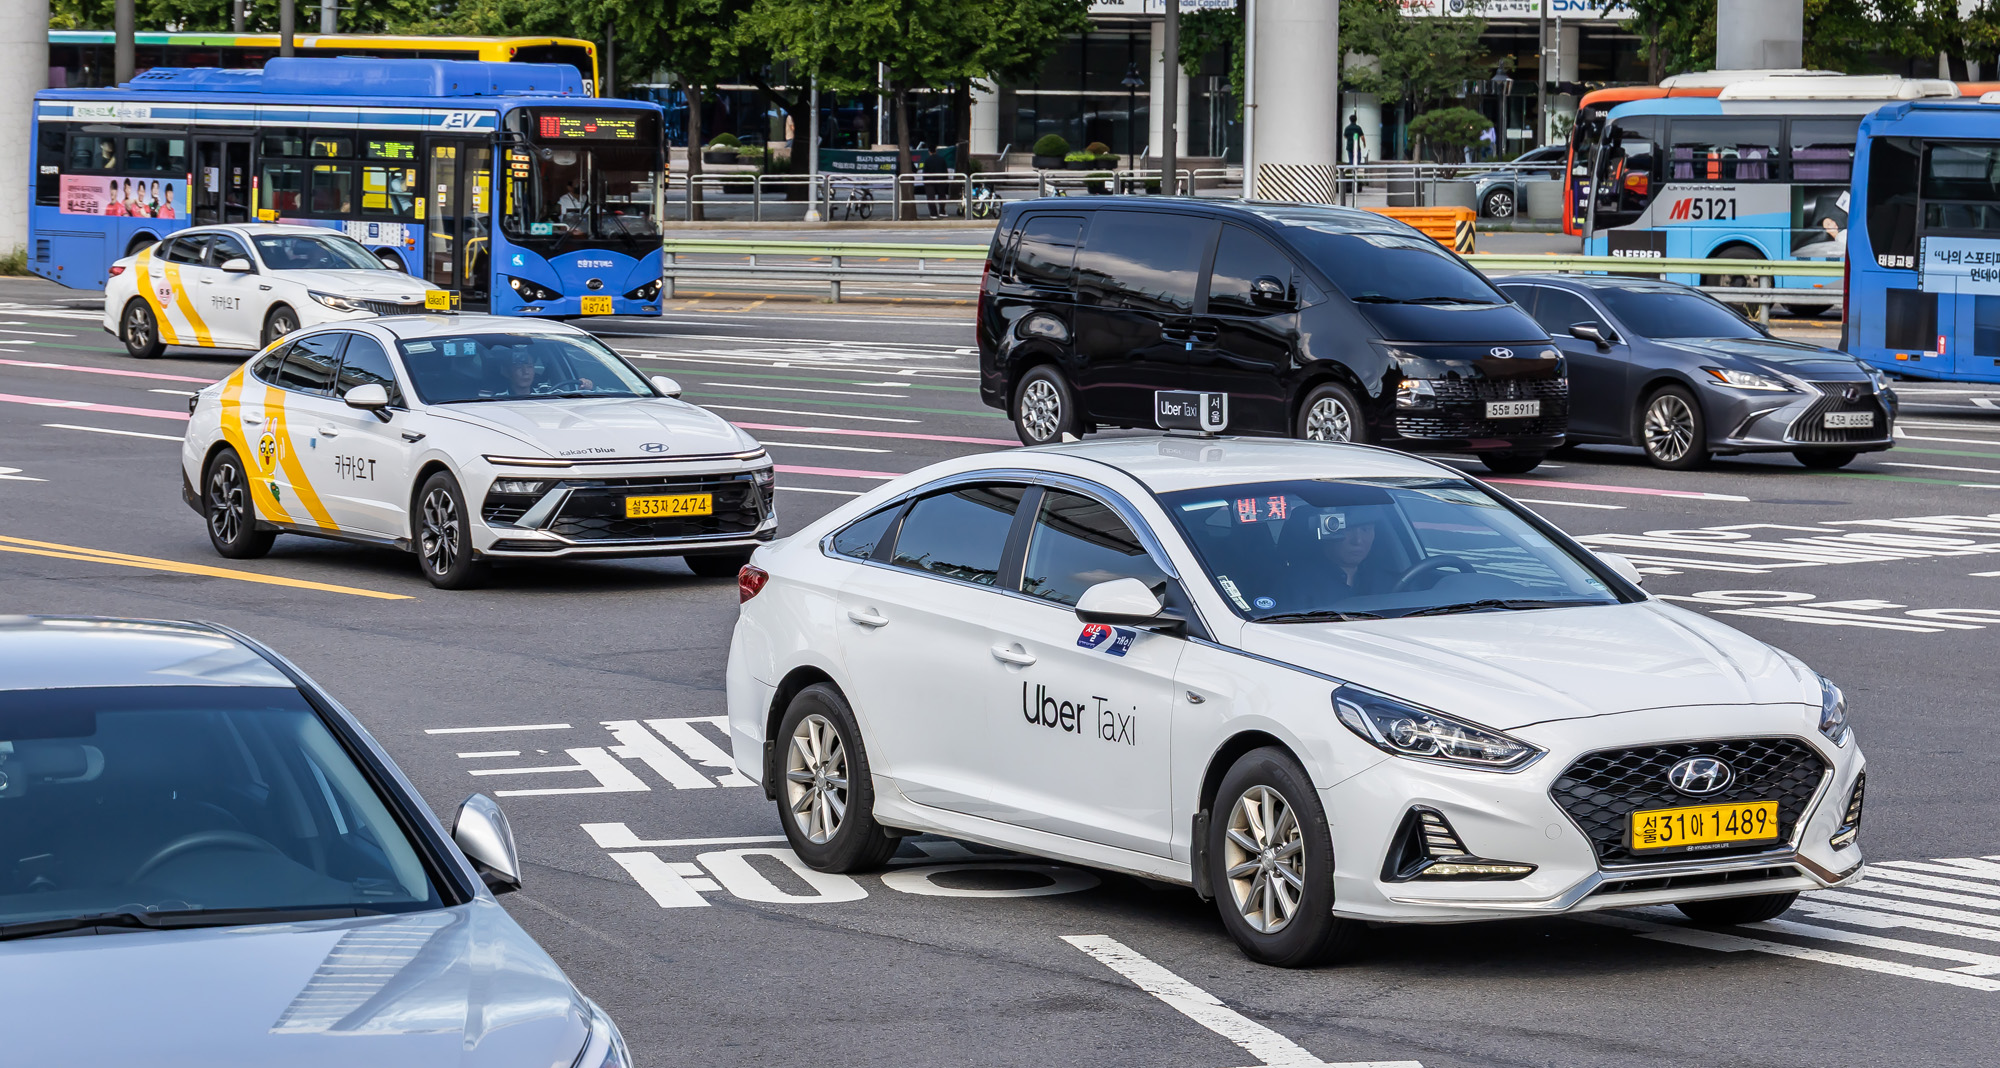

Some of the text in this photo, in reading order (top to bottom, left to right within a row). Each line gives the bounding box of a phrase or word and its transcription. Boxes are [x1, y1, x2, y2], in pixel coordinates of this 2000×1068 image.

[1669, 198, 1736, 220] M5121
[1878, 254, 1914, 268] 태릉교통
[1161, 401, 1198, 417] Uber Taxi
[1210, 397, 1221, 423] 서울
[1513, 403, 1535, 415] 5911
[334, 454, 366, 481] 카카오
[672, 497, 708, 514] 2474
[1022, 680, 1137, 746] Uber Taxi
[1711, 807, 1768, 840] 1489
